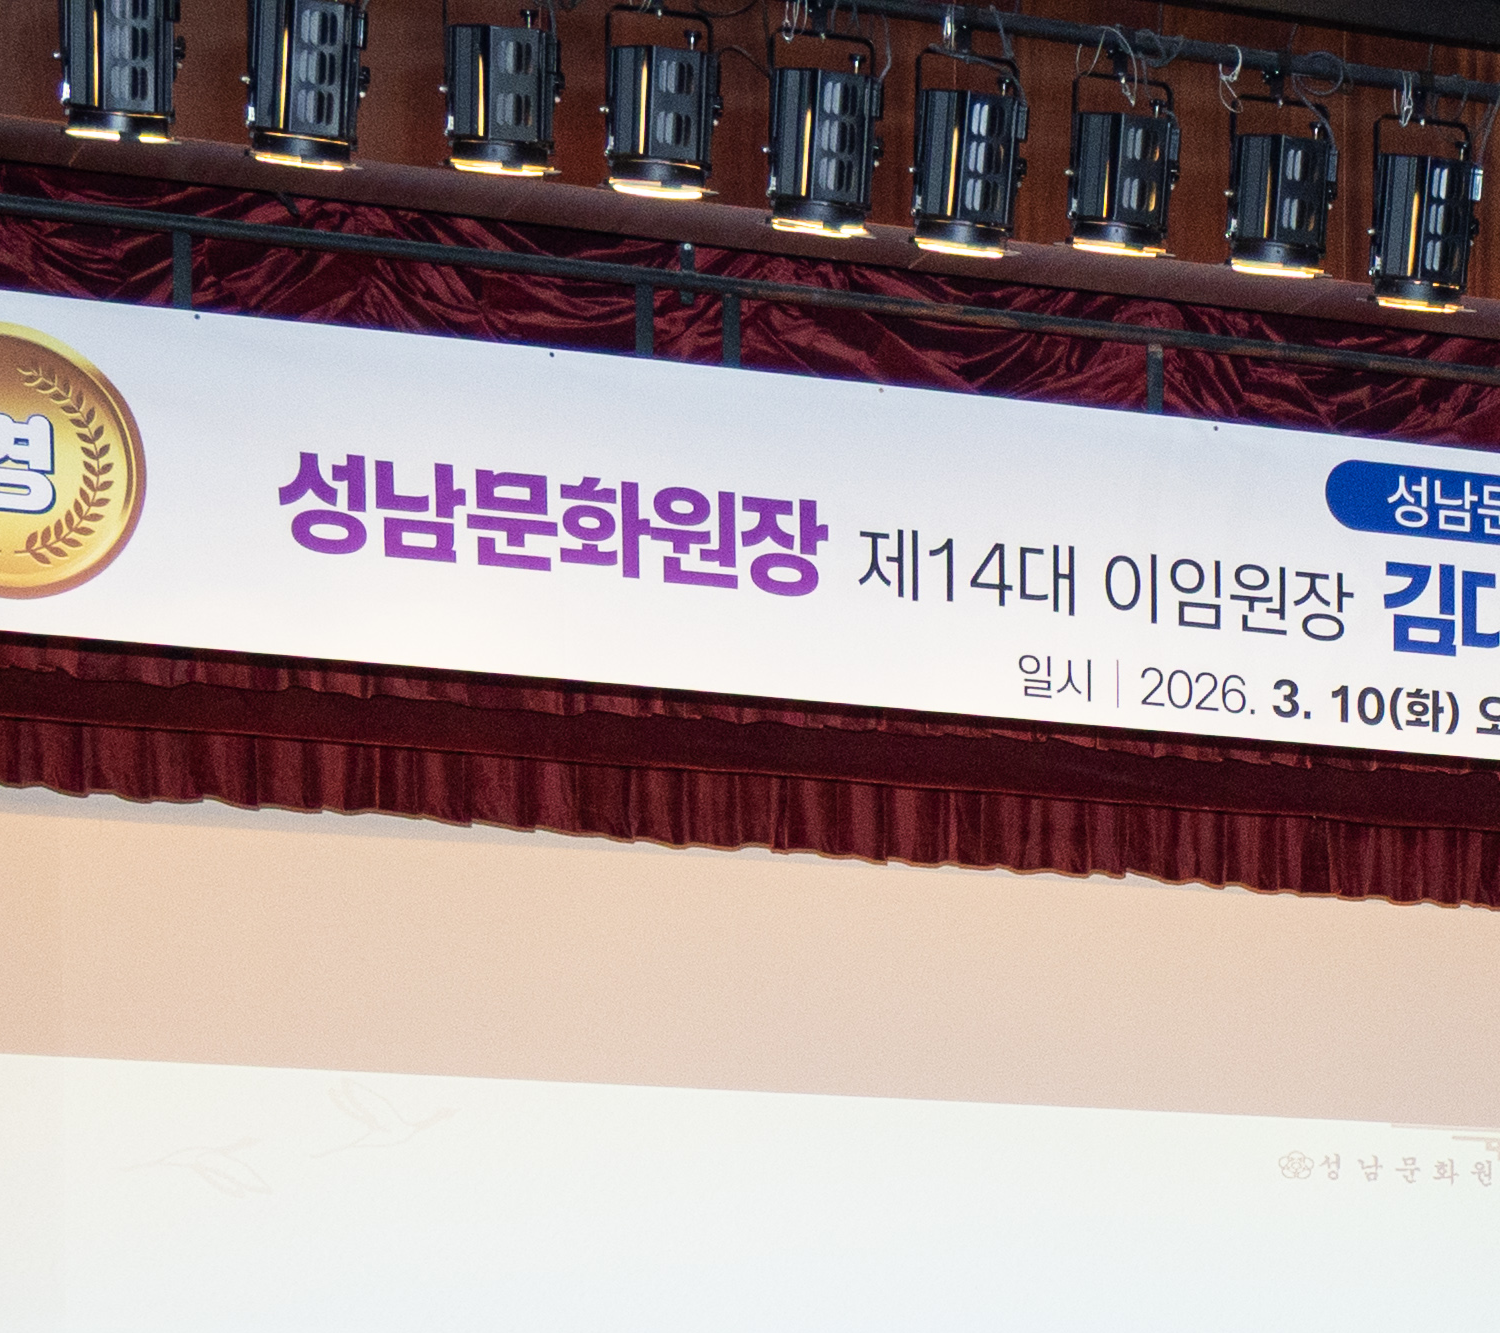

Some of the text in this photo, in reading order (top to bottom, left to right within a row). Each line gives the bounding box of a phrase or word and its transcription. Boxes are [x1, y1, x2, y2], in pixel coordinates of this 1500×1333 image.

[278, 451, 829, 598] 성남문화원장
[857, 528, 1078, 616] 제14대
[1103, 551, 1355, 642] 이임원장
[1017, 652, 1096, 703] 일시
[1138, 665, 1257, 716] 2026.
[1270, 678, 1313, 720] 3.
[1330, 682, 1461, 737] 10(화)
[1320, 1153, 1493, 1187] 성남문화원
